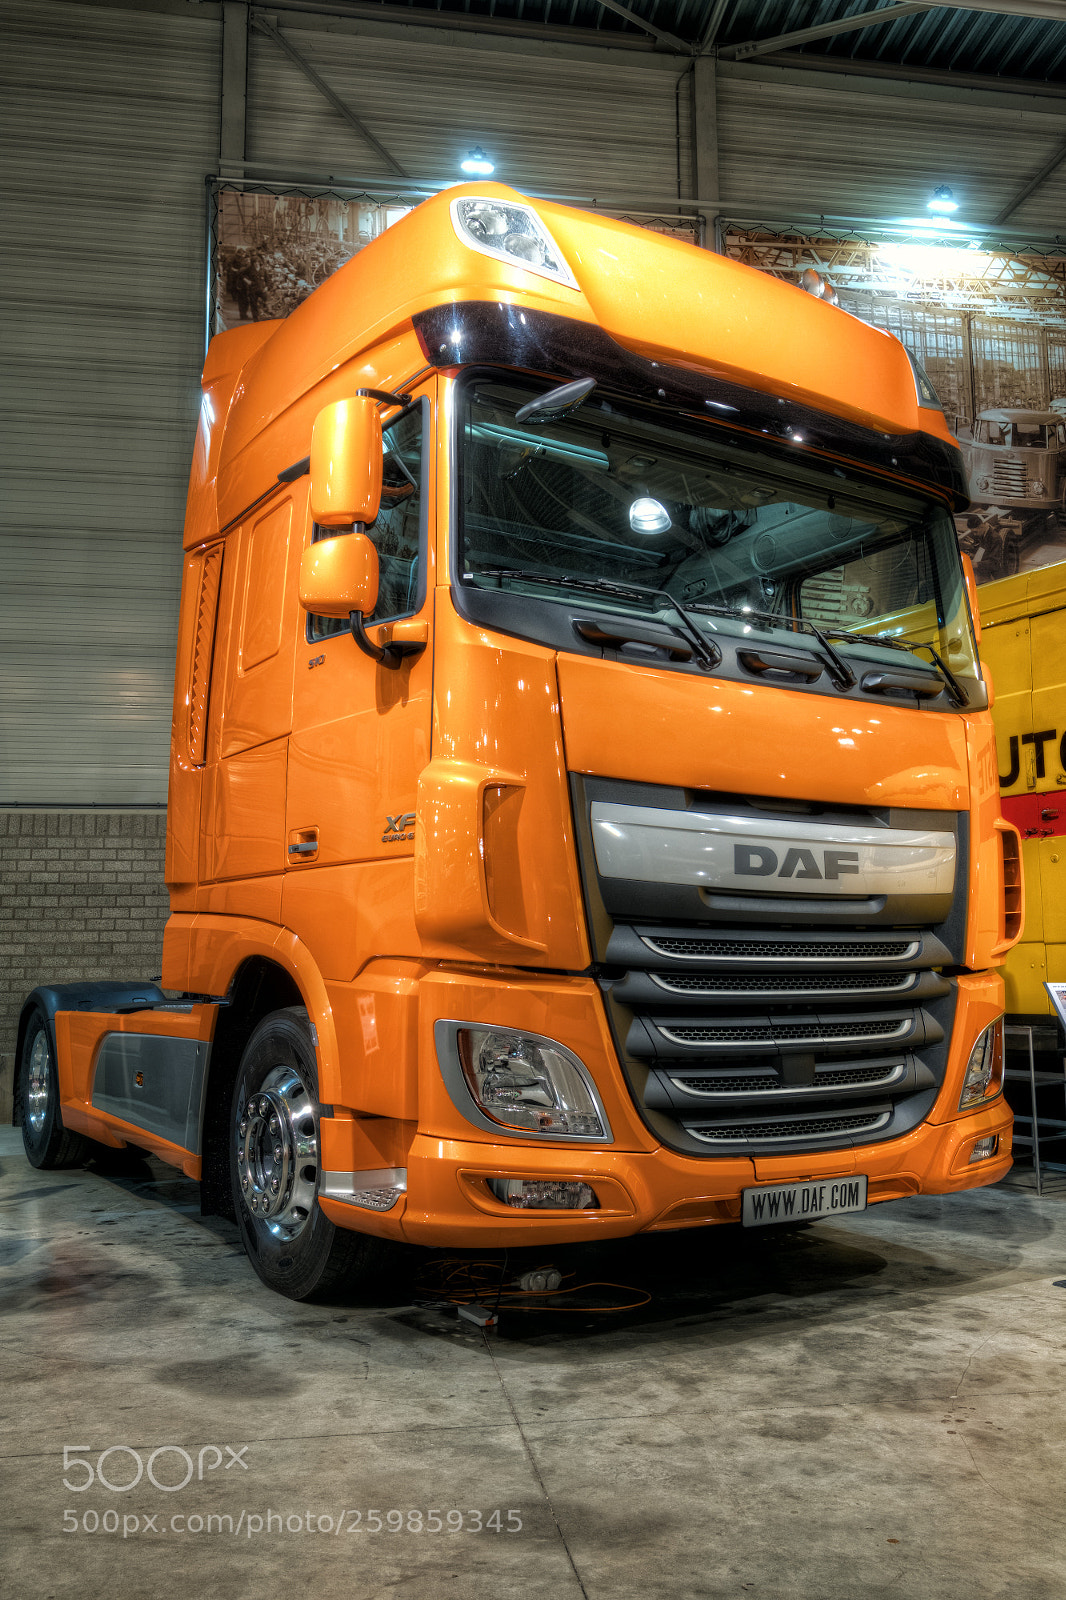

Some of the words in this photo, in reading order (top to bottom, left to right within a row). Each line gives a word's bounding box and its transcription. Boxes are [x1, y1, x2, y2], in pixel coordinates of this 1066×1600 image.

[998, 729, 1066, 788] UT
[381, 833, 406, 843] EURO
[384, 813, 416, 834] XF
[734, 844, 859, 880] DAF
[752, 1181, 860, 1220] WWW.DAF.COM
